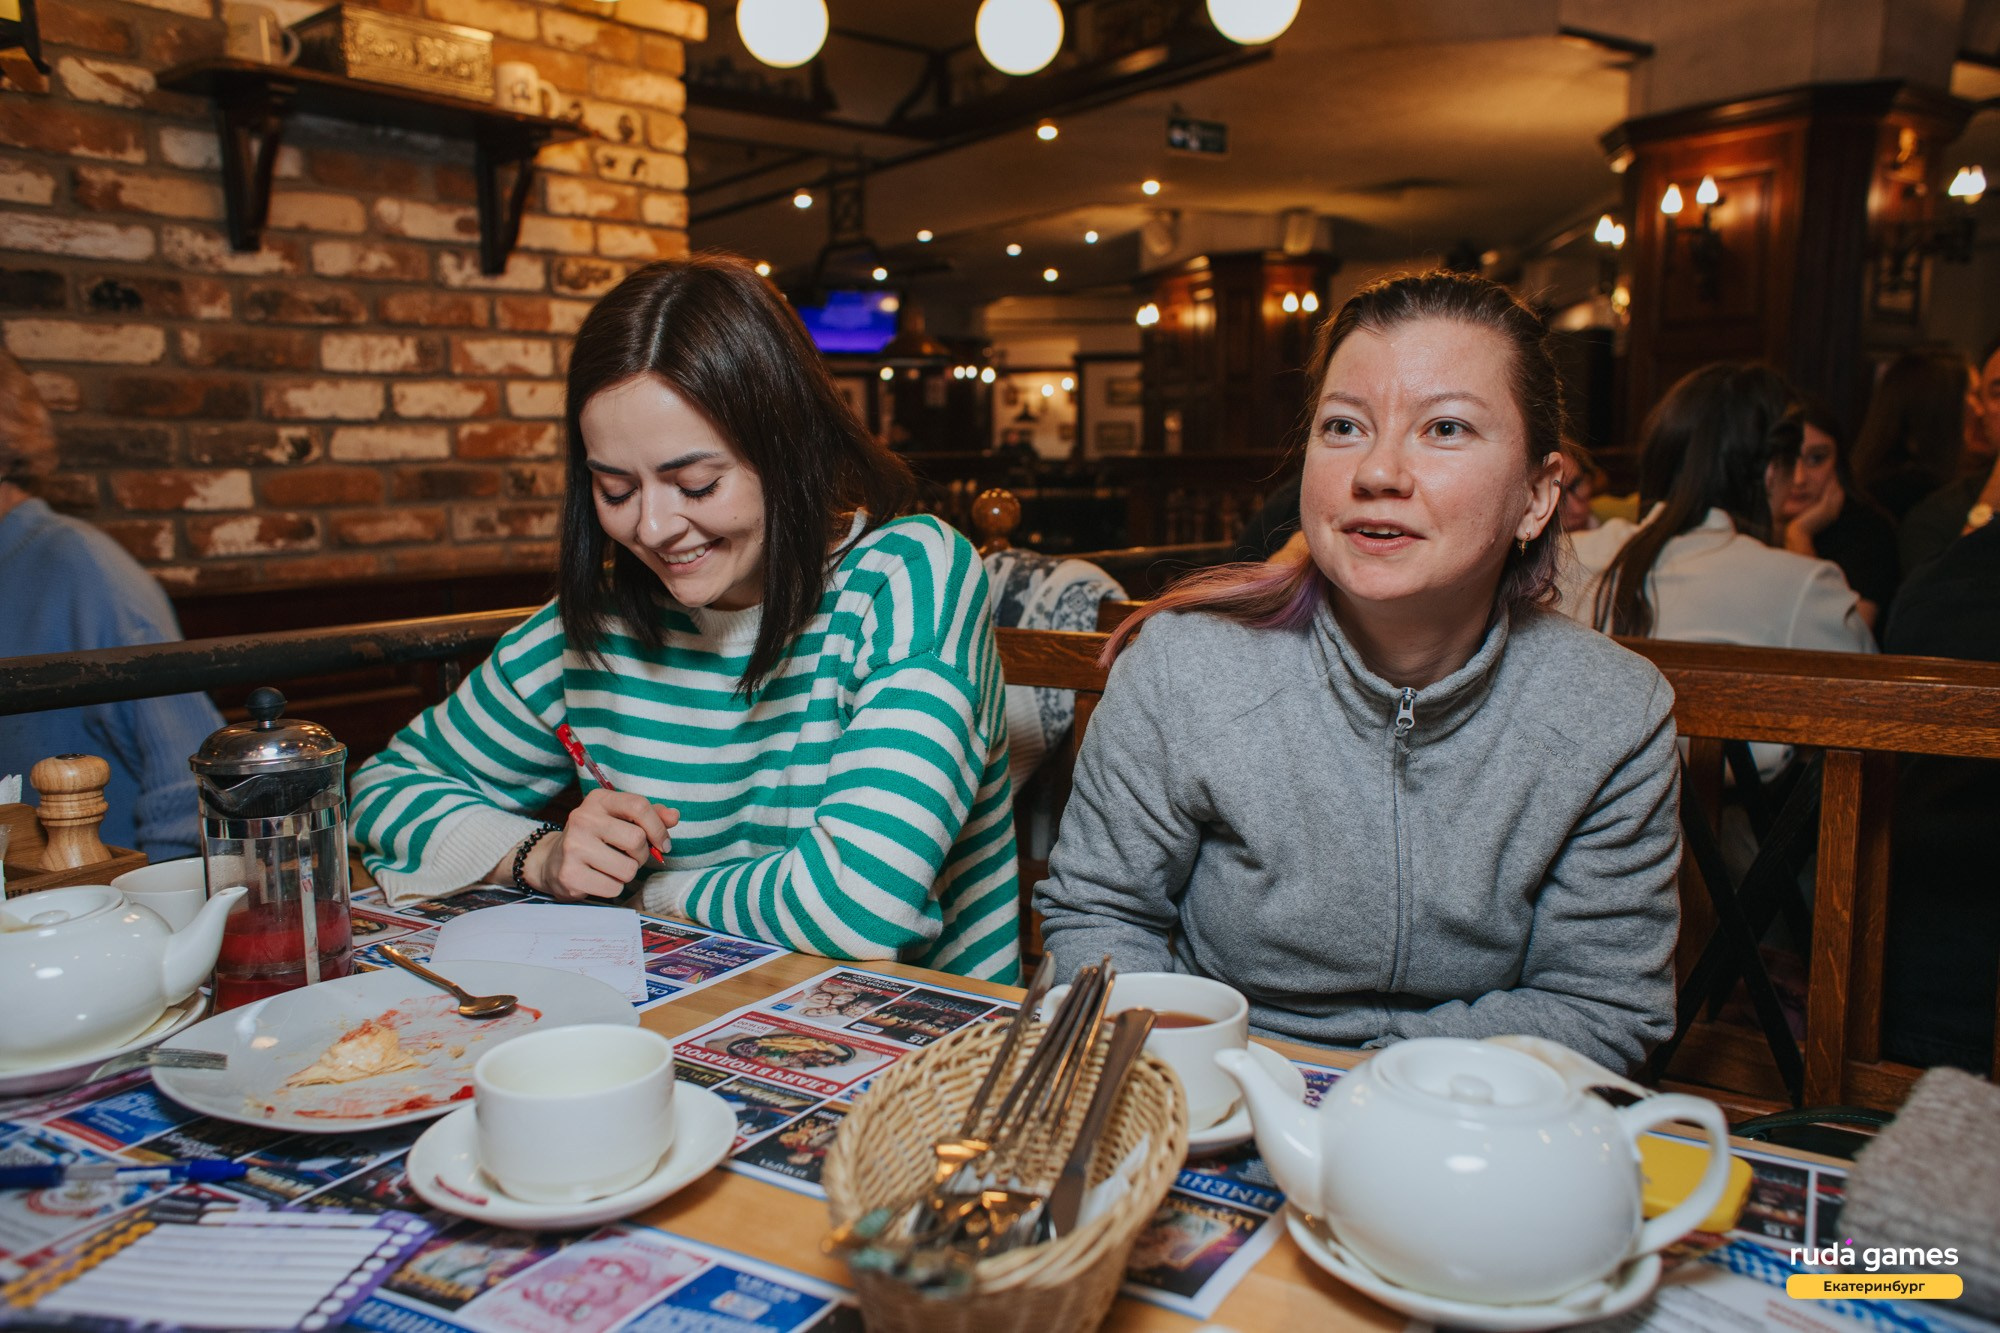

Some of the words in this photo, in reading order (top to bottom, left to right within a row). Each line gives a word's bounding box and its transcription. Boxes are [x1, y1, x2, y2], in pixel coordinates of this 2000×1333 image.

[906, 1034, 926, 1045] 15
[674, 1044, 757, 1075] ПОДАРОК
[757, 1067, 769, 1077] В
[768, 1072, 824, 1091] ЛАНЧ
[825, 1083, 839, 1093] 6
